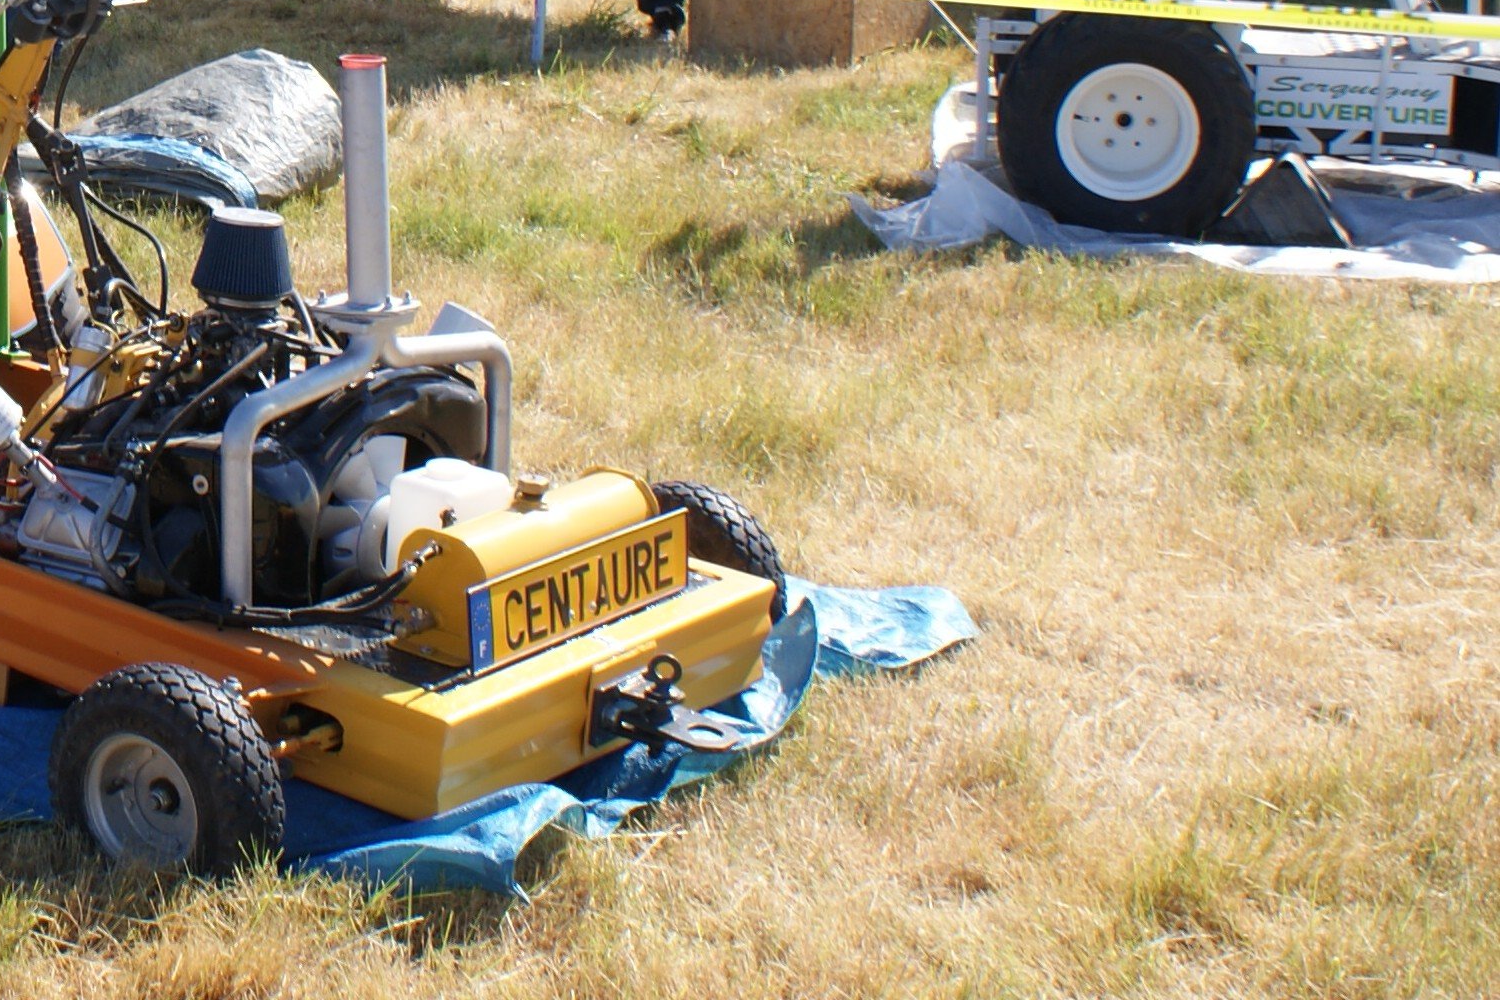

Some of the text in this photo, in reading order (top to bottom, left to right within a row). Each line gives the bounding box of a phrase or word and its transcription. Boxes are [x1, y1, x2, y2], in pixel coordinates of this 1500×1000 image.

[1255, 99, 1448, 126] COUVERURE
[504, 532, 674, 652] CENTAURE
[479, 640, 487, 659] F
